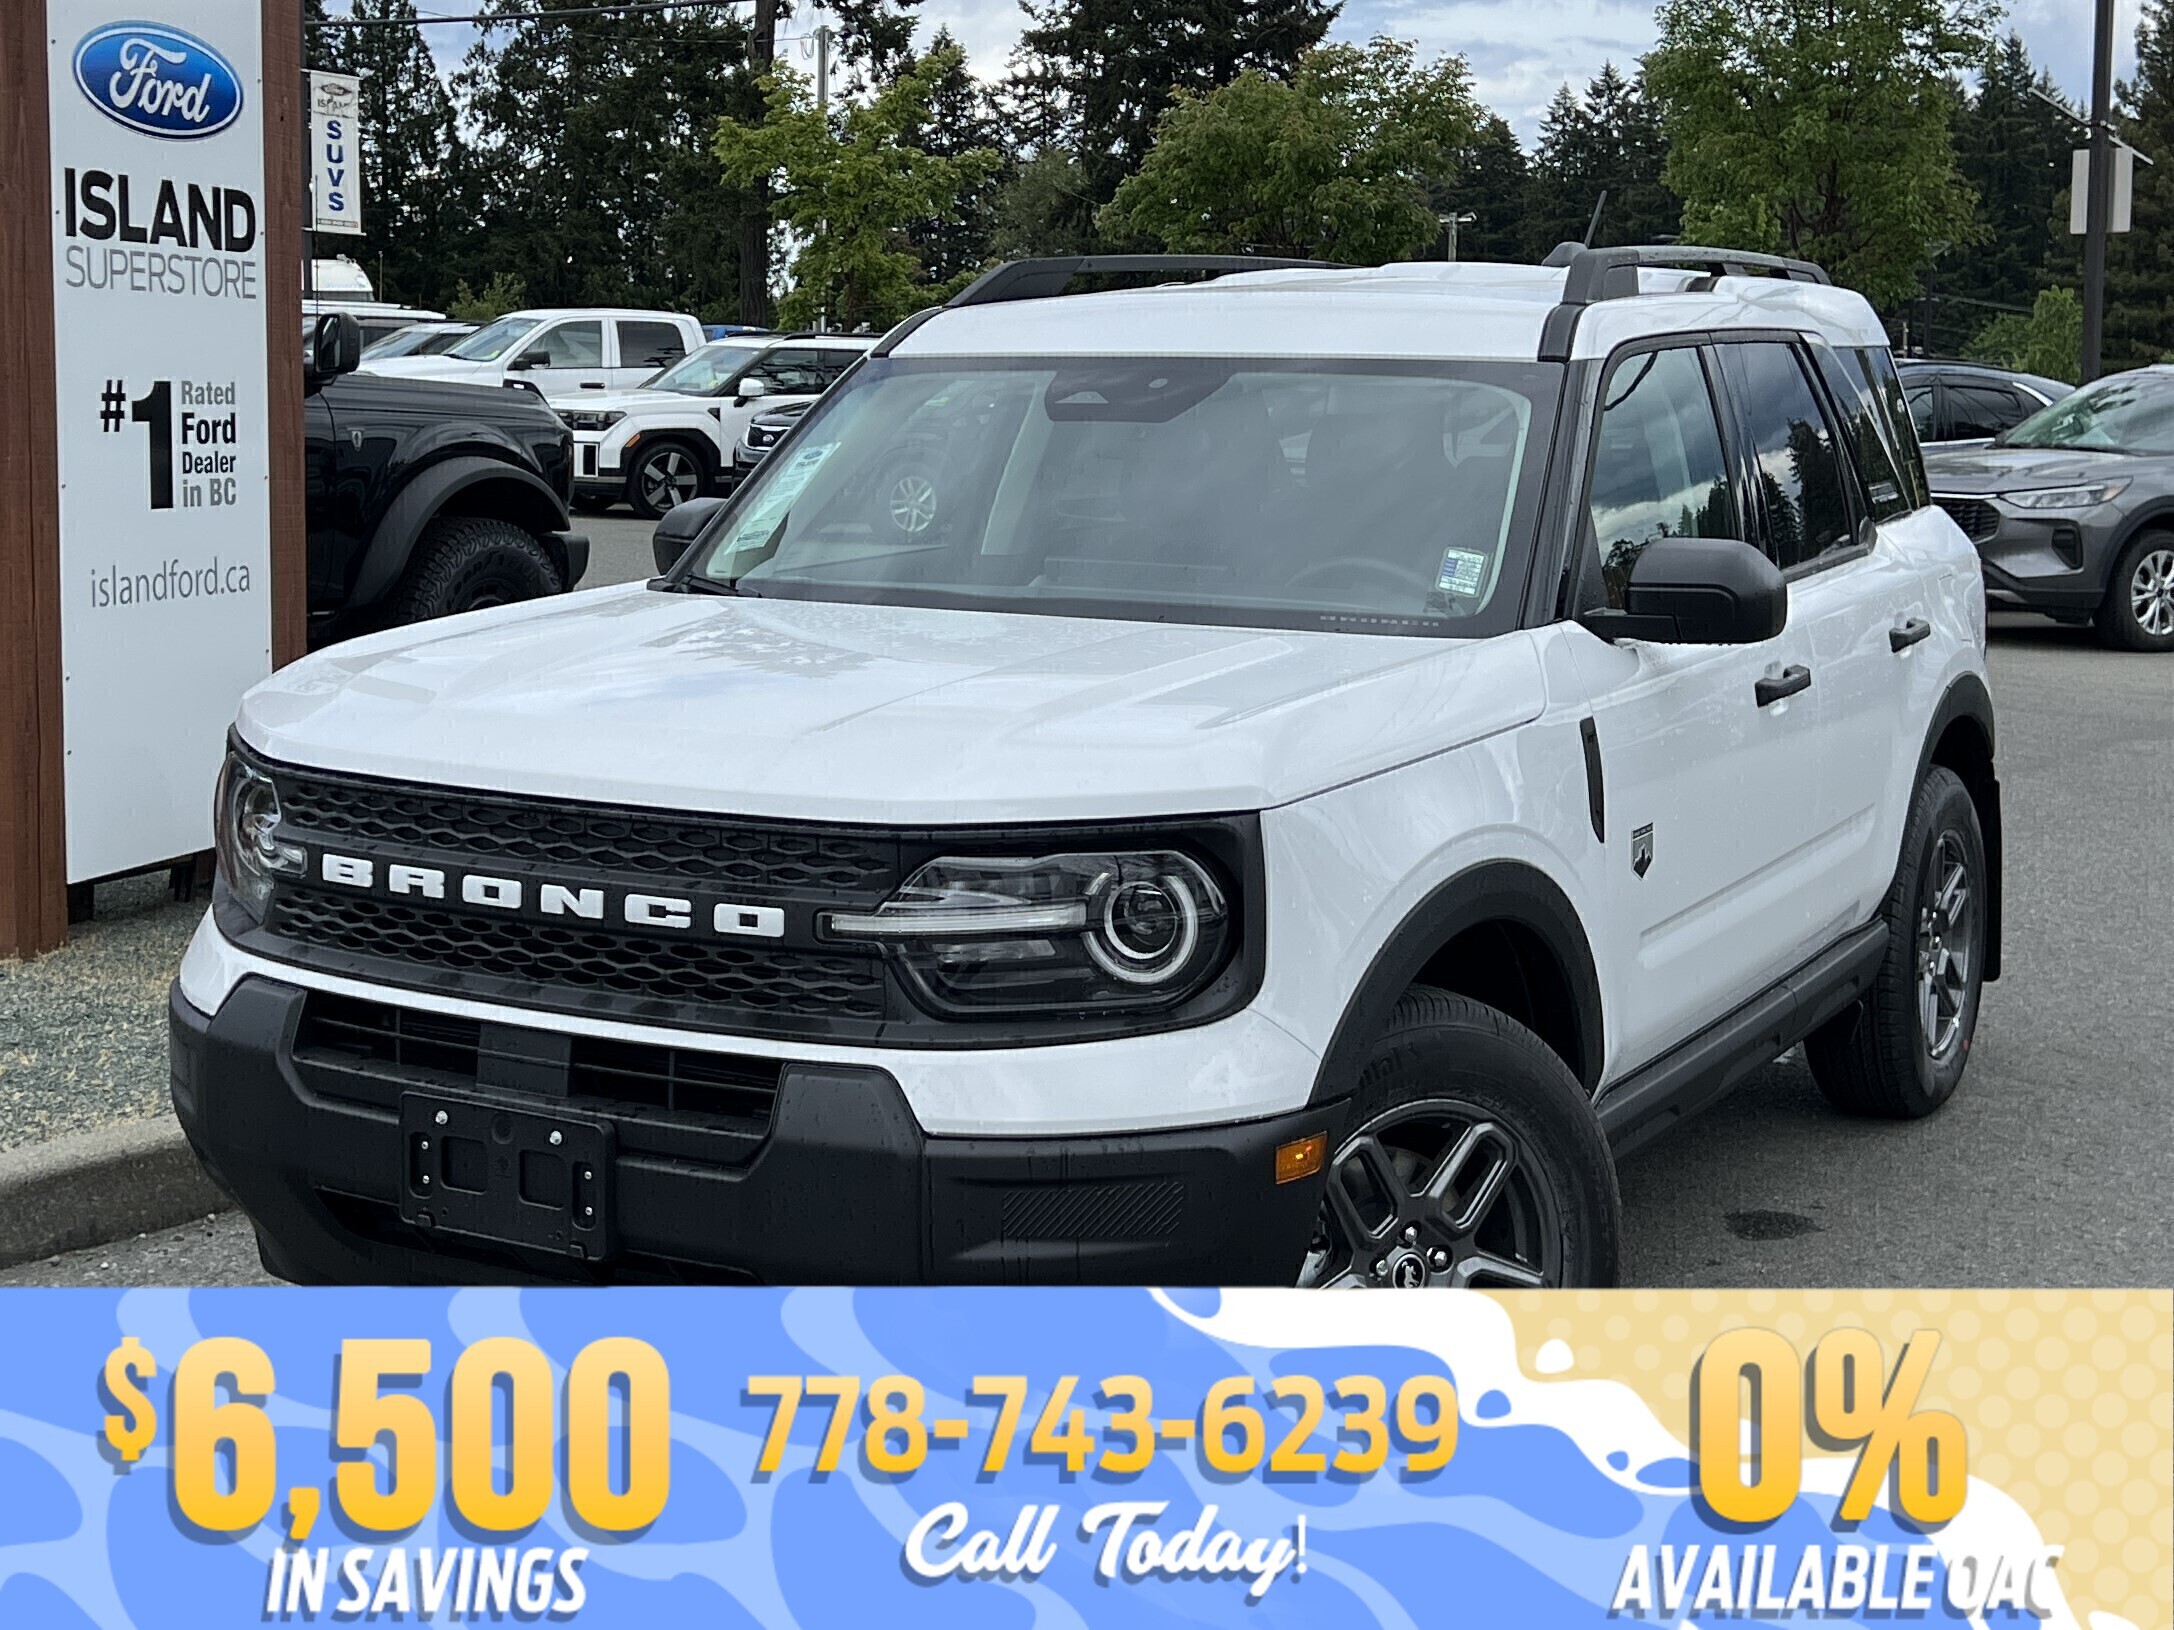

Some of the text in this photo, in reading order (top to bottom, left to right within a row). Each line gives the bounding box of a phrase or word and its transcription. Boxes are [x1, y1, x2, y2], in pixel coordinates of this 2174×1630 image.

[109, 38, 210, 124] Ford
[326, 119, 345, 212] SUVS
[63, 167, 256, 253] ISLAND
[65, 245, 257, 300] SUPERSTORE
[181, 380, 236, 406] Rated
[100, 379, 174, 510] #1
[181, 412, 237, 446] Ford
[182, 452, 237, 475] Dealer
[182, 478, 237, 508] in BC
[90, 556, 251, 608] islandford.ca
[321, 853, 785, 938] BRONCO
